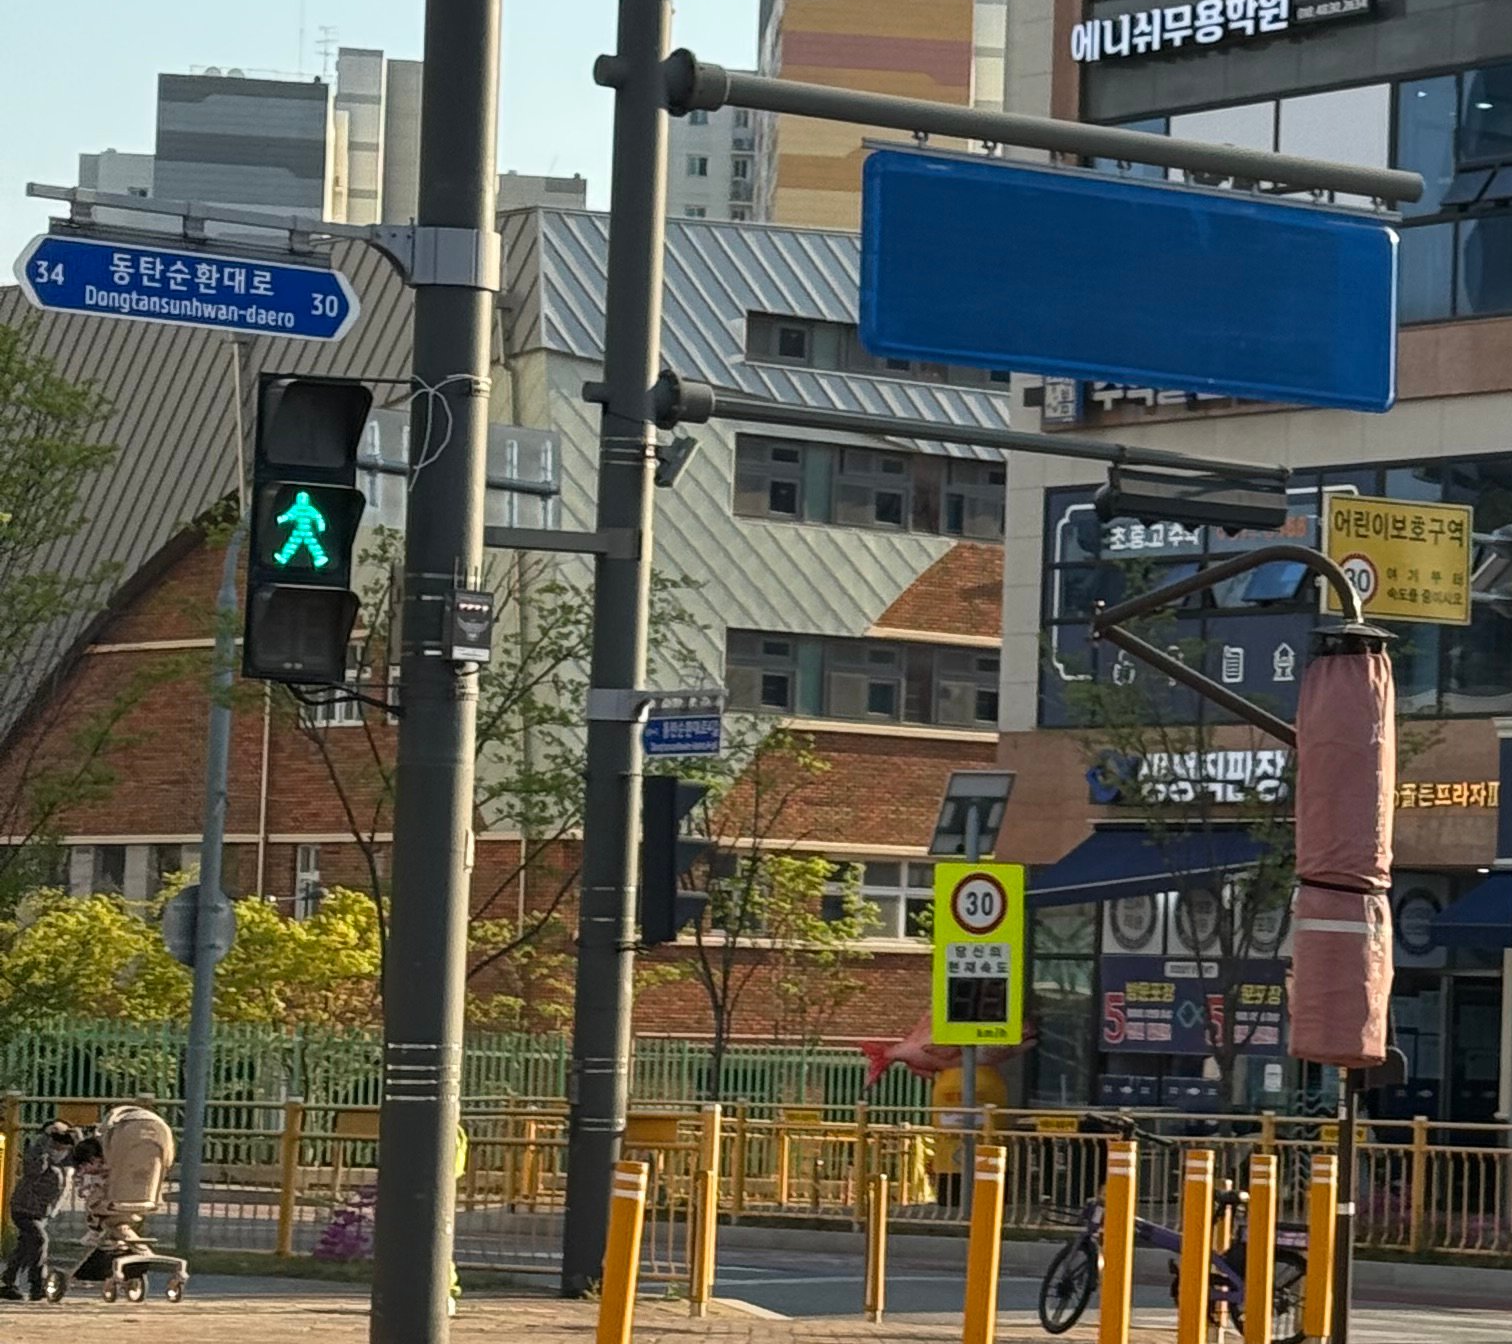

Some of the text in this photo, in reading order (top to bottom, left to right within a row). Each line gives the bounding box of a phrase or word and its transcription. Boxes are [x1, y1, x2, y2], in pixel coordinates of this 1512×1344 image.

[34, 252, 340, 318] 34 동탄순환대로 30
[85, 284, 295, 329] Dongtansunhwan-daero
[1333, 508, 1465, 549] 어린이보호구역
[965, 891, 994, 917] 30
